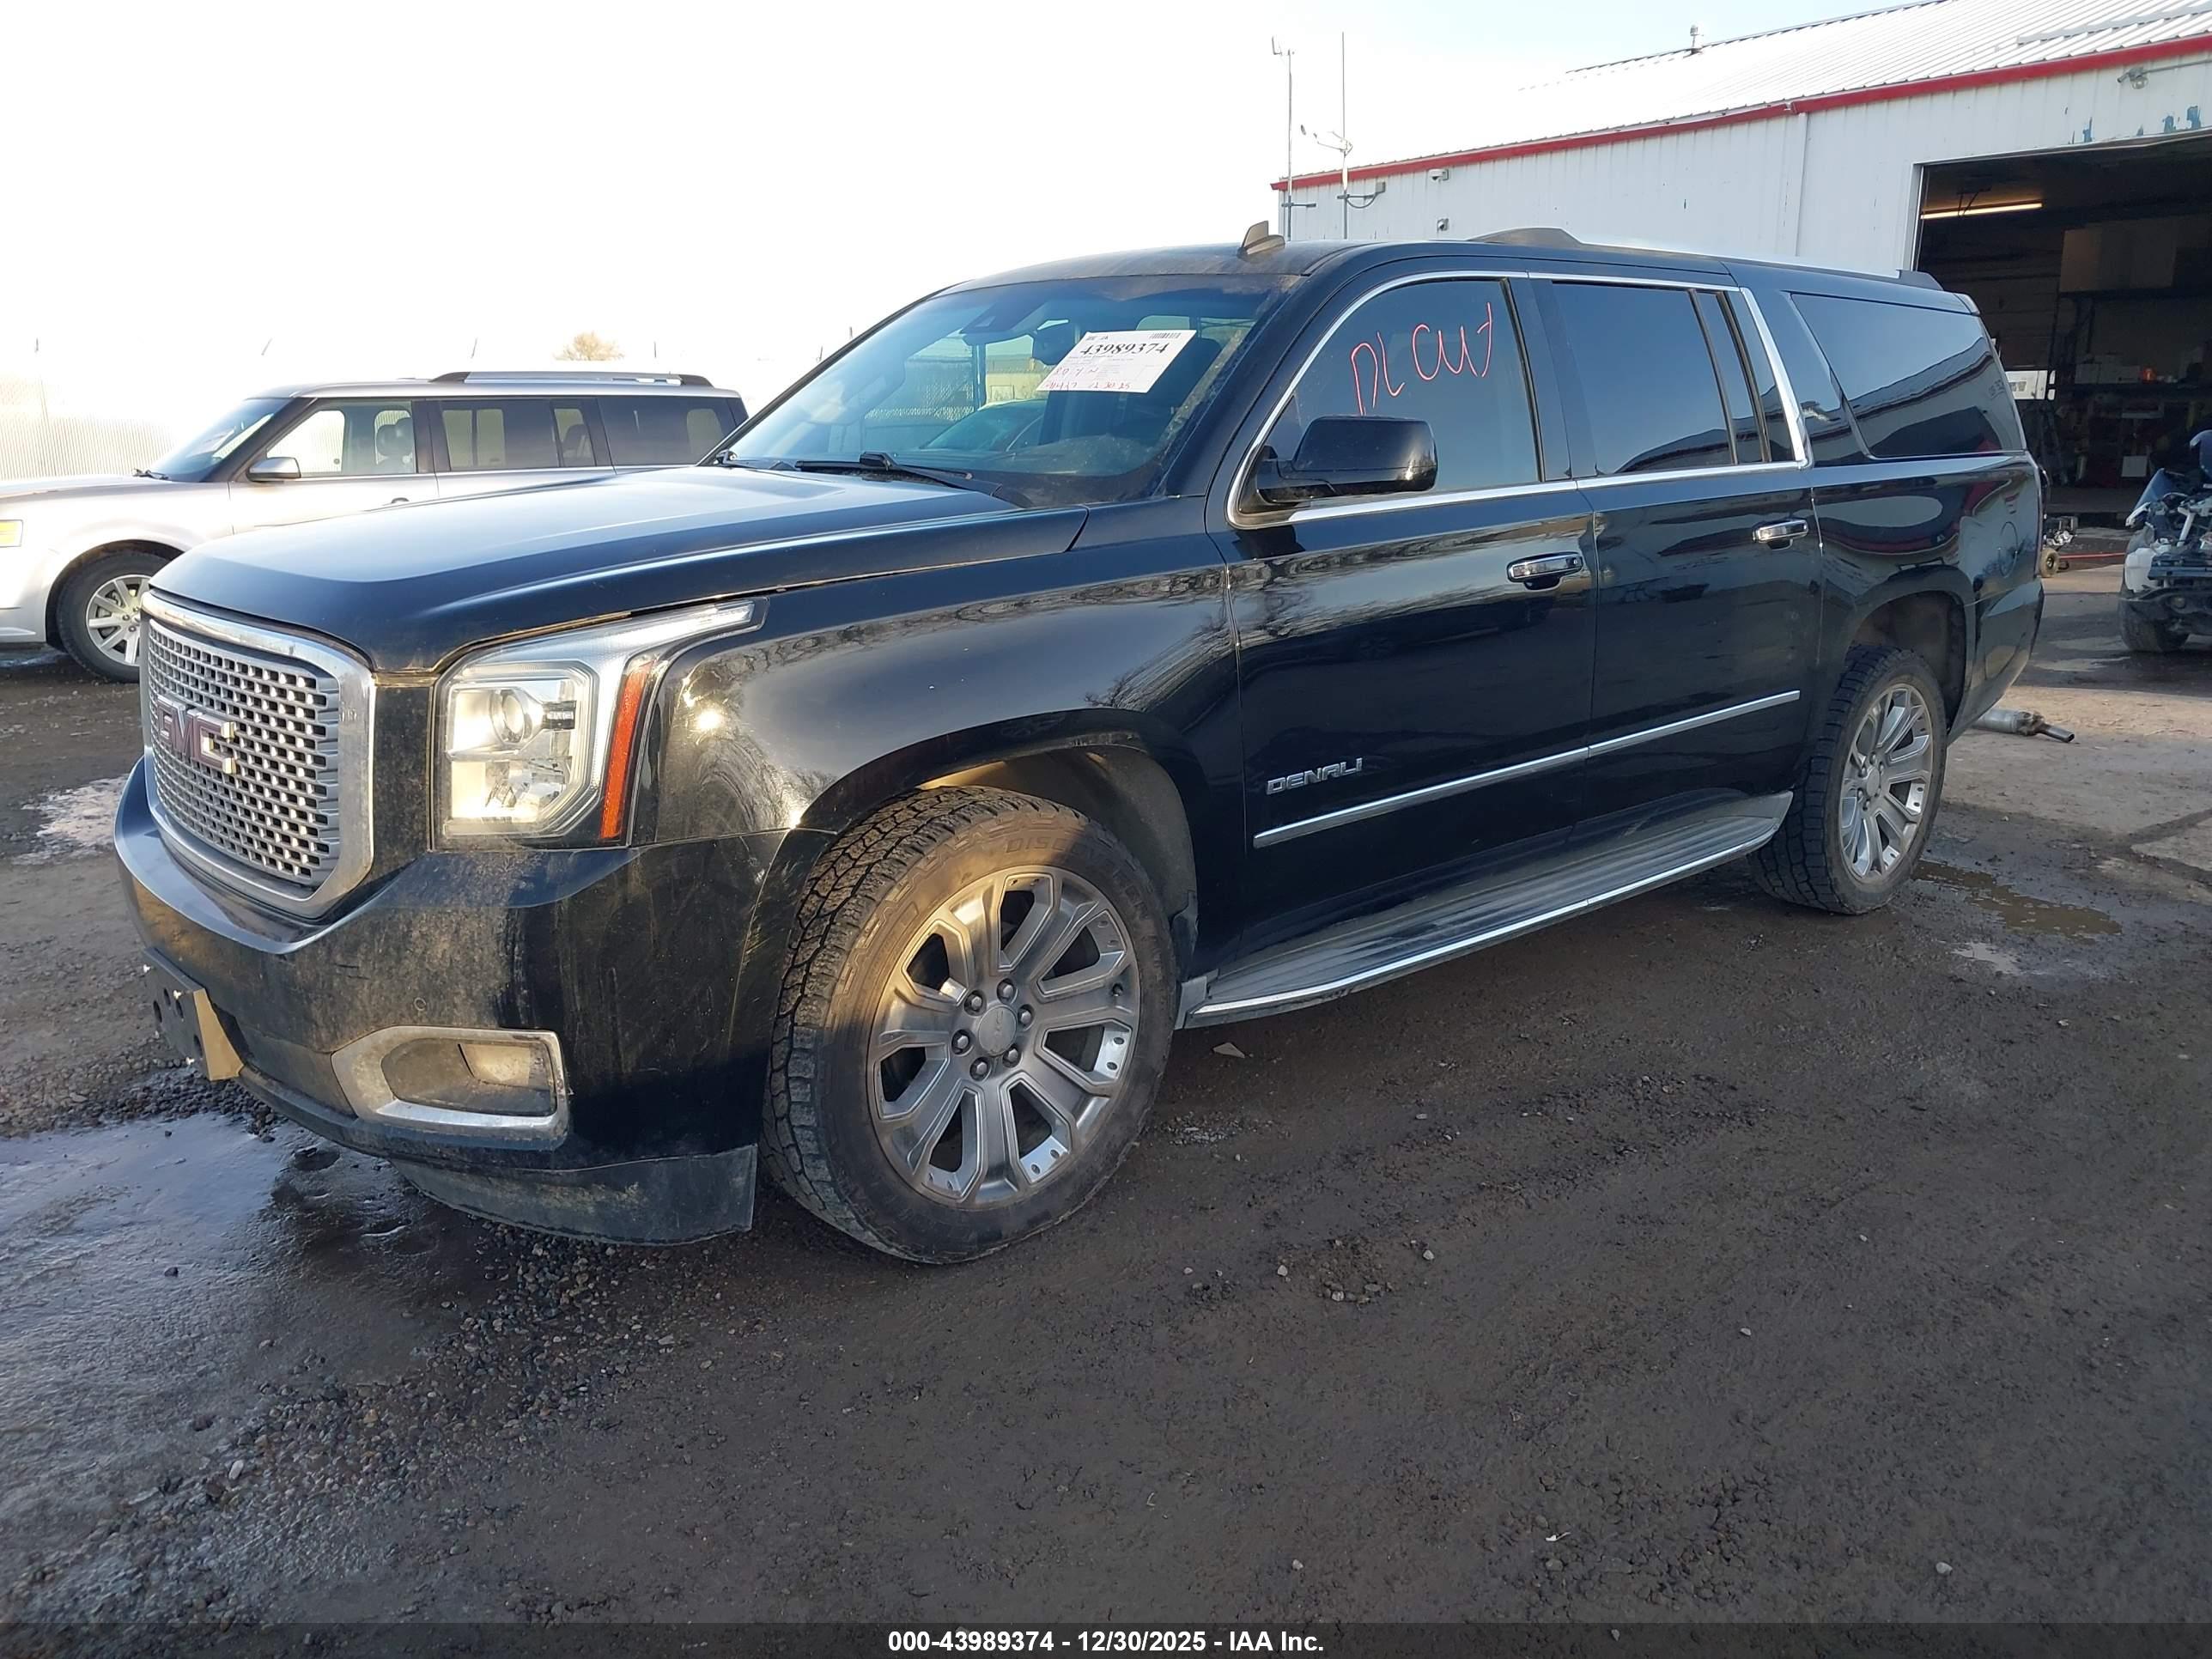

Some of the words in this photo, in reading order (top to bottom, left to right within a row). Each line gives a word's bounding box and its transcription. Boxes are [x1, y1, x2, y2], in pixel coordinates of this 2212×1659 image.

[1079, 342, 1170, 356] 43989374
[155, 696, 237, 775] GMC
[1267, 757, 1364, 795] DENALI
